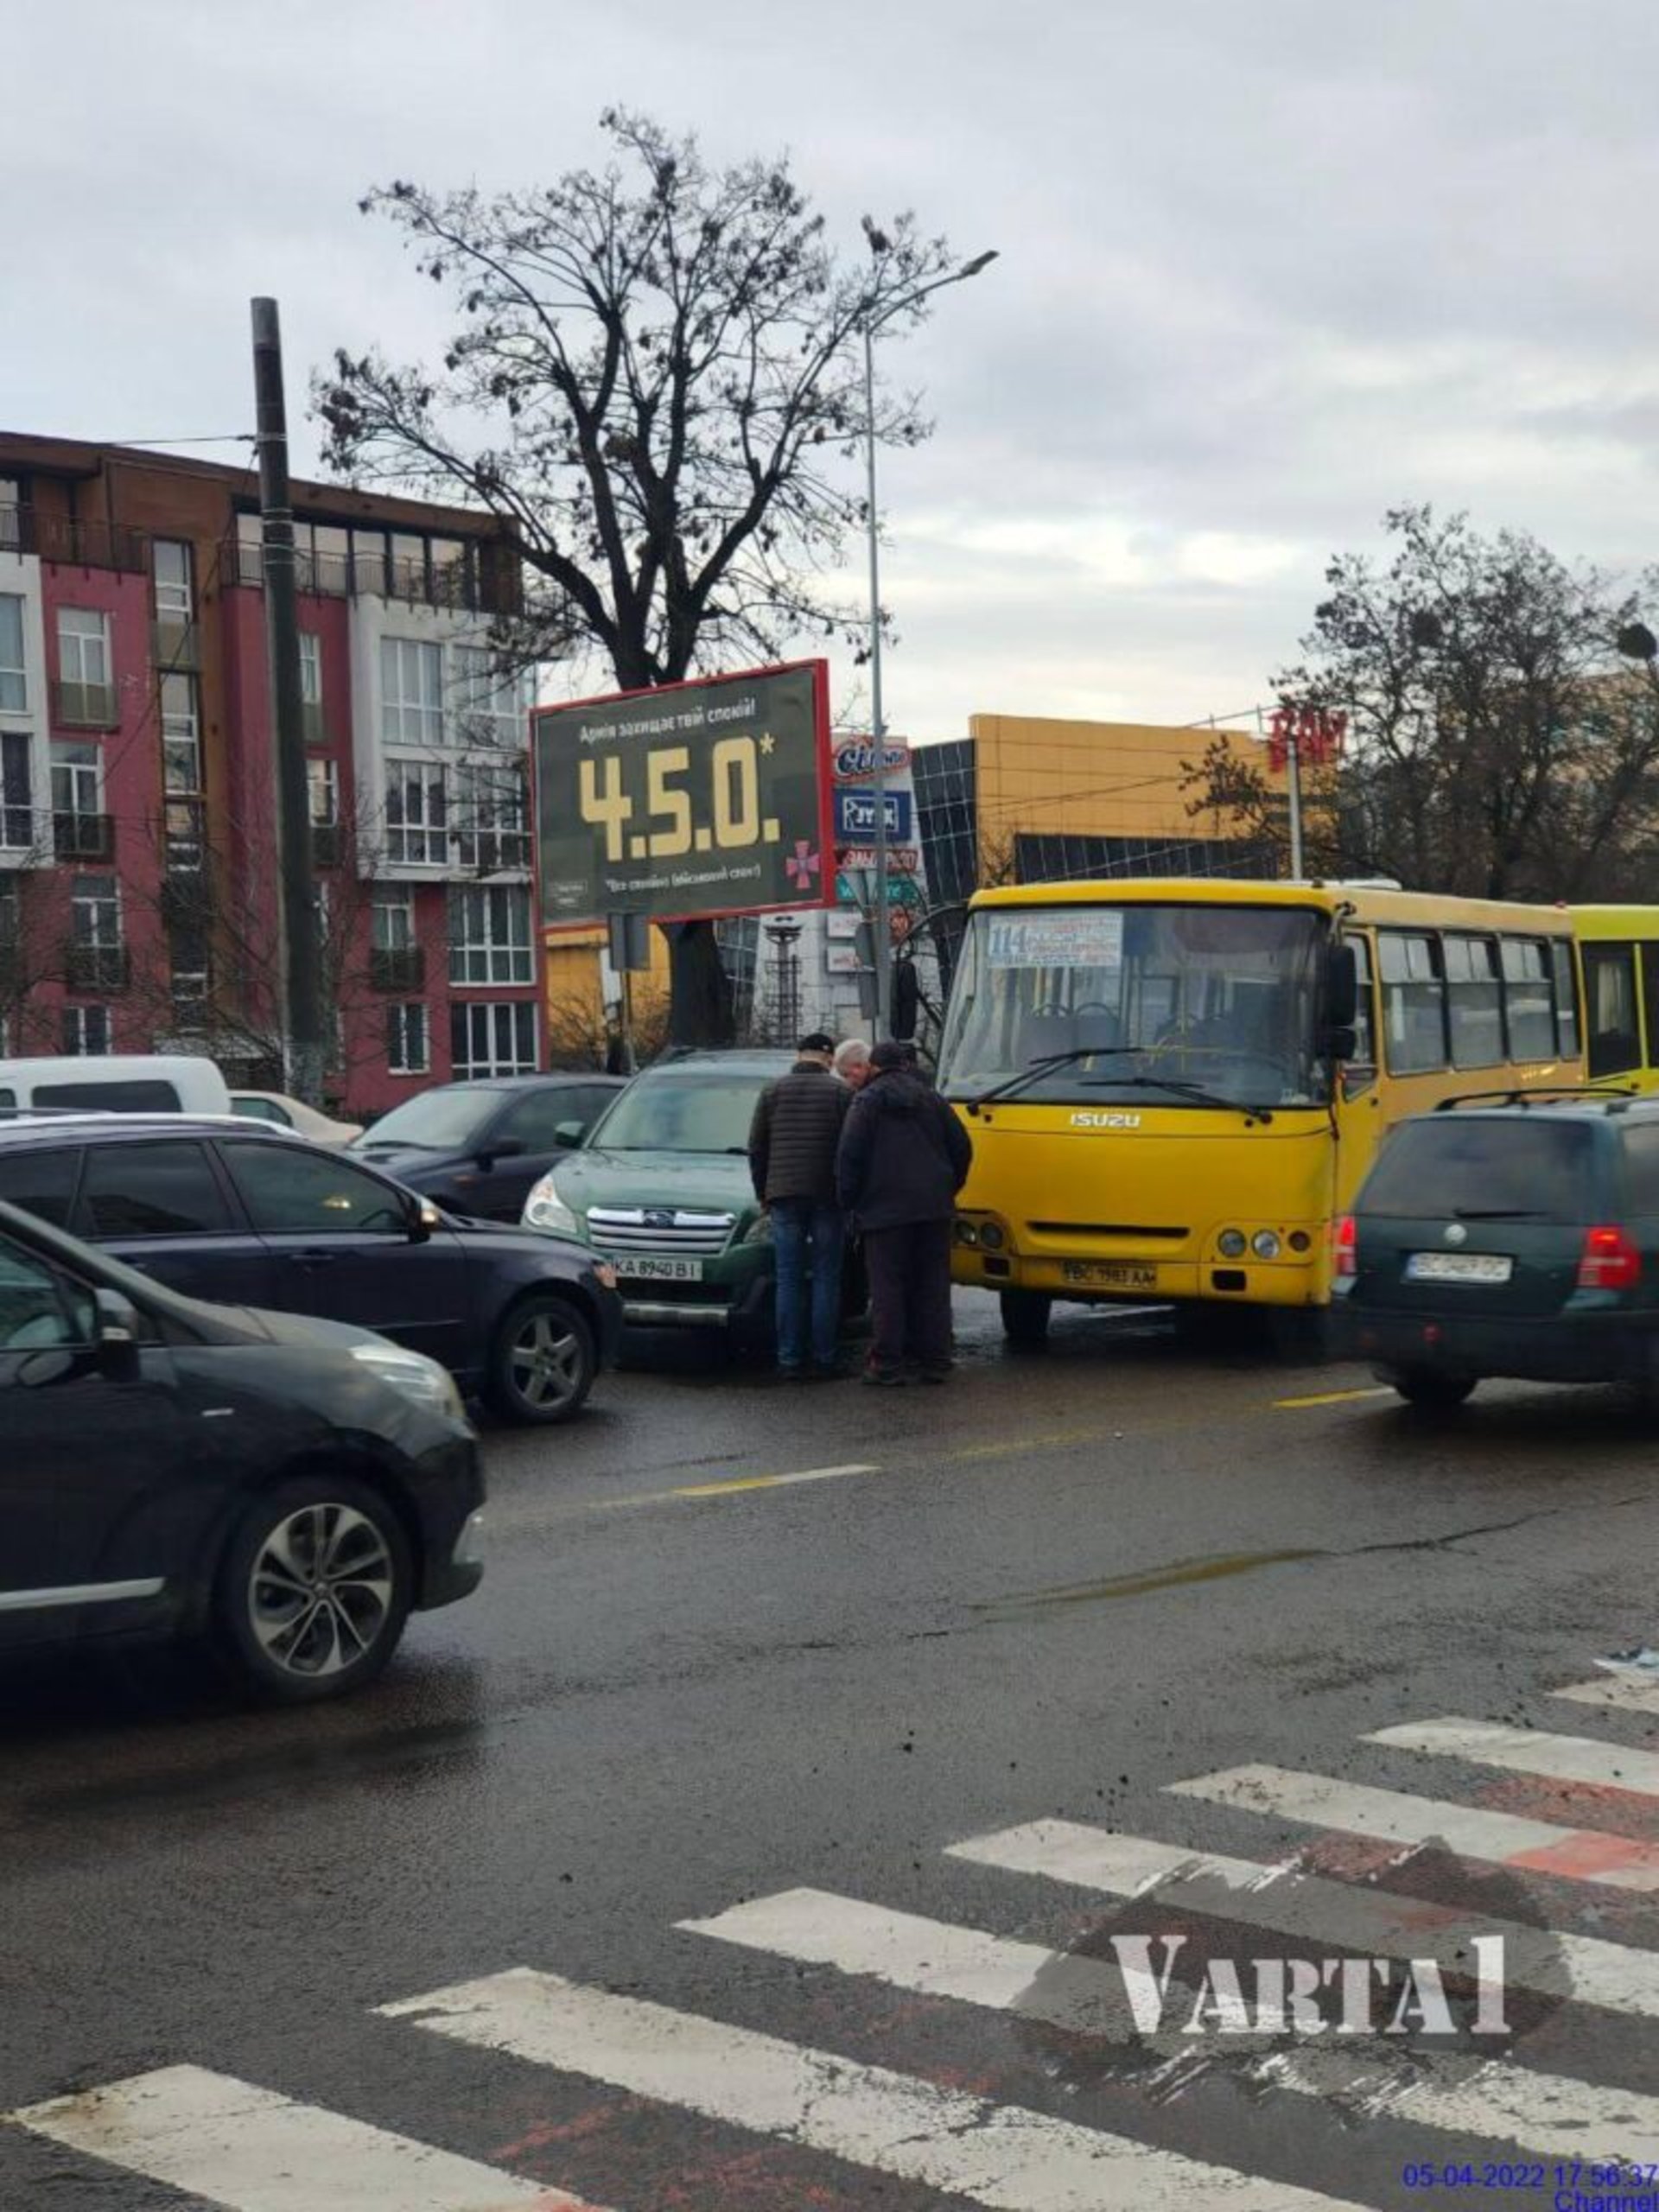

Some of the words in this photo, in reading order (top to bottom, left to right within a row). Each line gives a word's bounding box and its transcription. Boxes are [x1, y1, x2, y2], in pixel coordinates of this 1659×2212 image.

[619, 715, 676, 737] захищає
[677, 705, 705, 728] твій
[707, 697, 756, 722] спокій!
[855, 804, 894, 825] JYK
[992, 924, 1027, 953] 114
[1071, 1112, 1141, 1128] ISUZU
[639, 1261, 673, 1277] 8940
